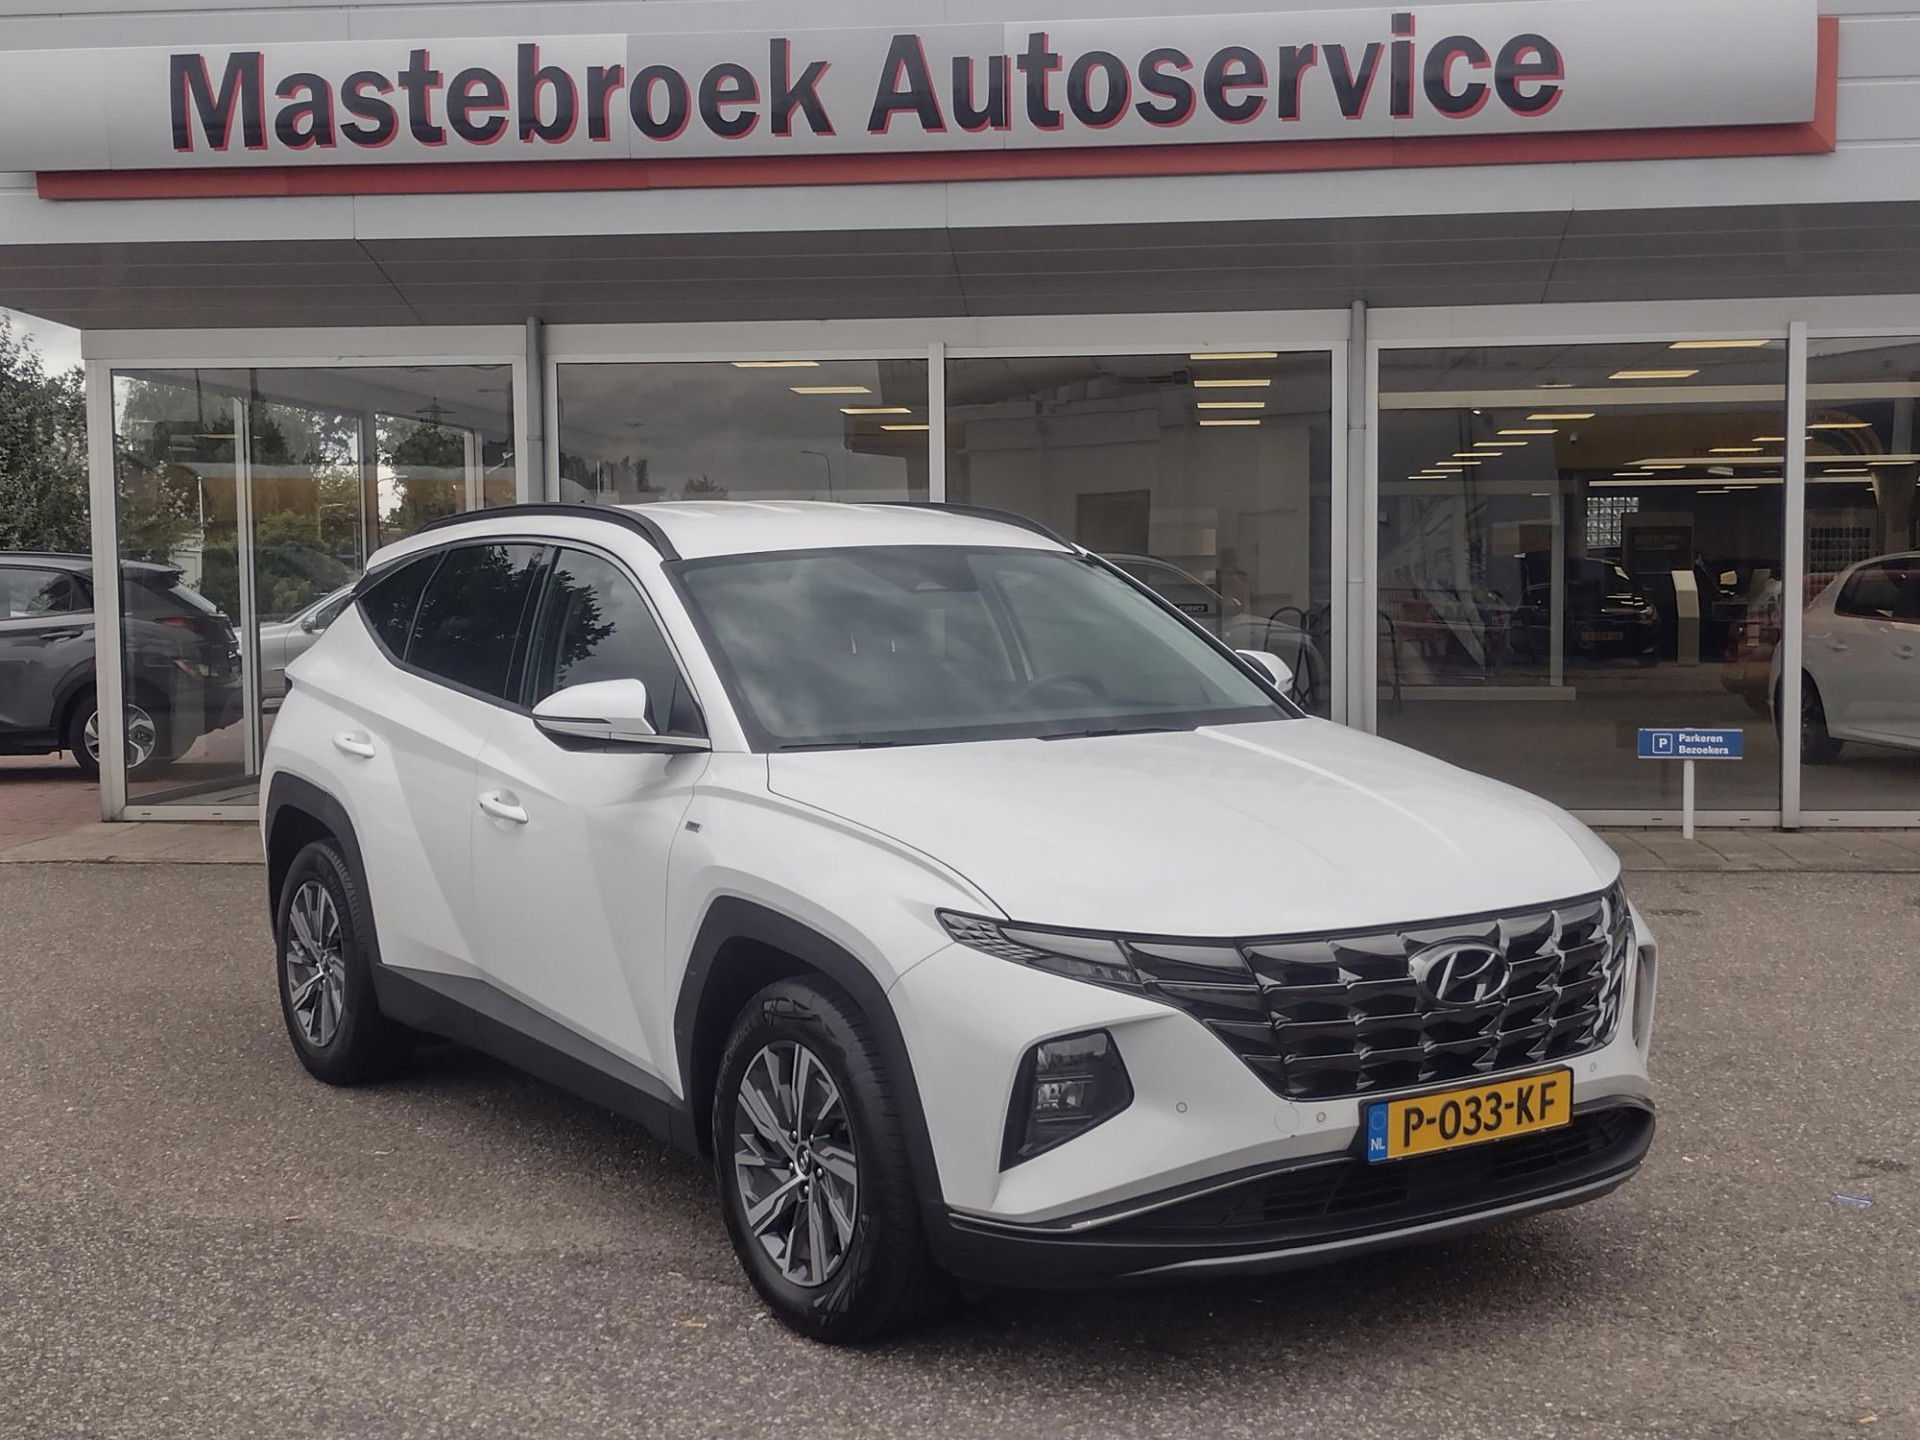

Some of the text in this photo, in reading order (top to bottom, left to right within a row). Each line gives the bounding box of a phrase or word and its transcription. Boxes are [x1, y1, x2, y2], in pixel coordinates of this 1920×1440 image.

[169, 12, 1565, 152] Mastebroek Autoservice
[1659, 738, 1668, 748] P
[1678, 733, 1724, 743] Parkeren
[1678, 745, 1730, 755] Bezoekers
[1403, 1080, 1557, 1148] P-033-KF
[1370, 1137, 1386, 1151] NL
